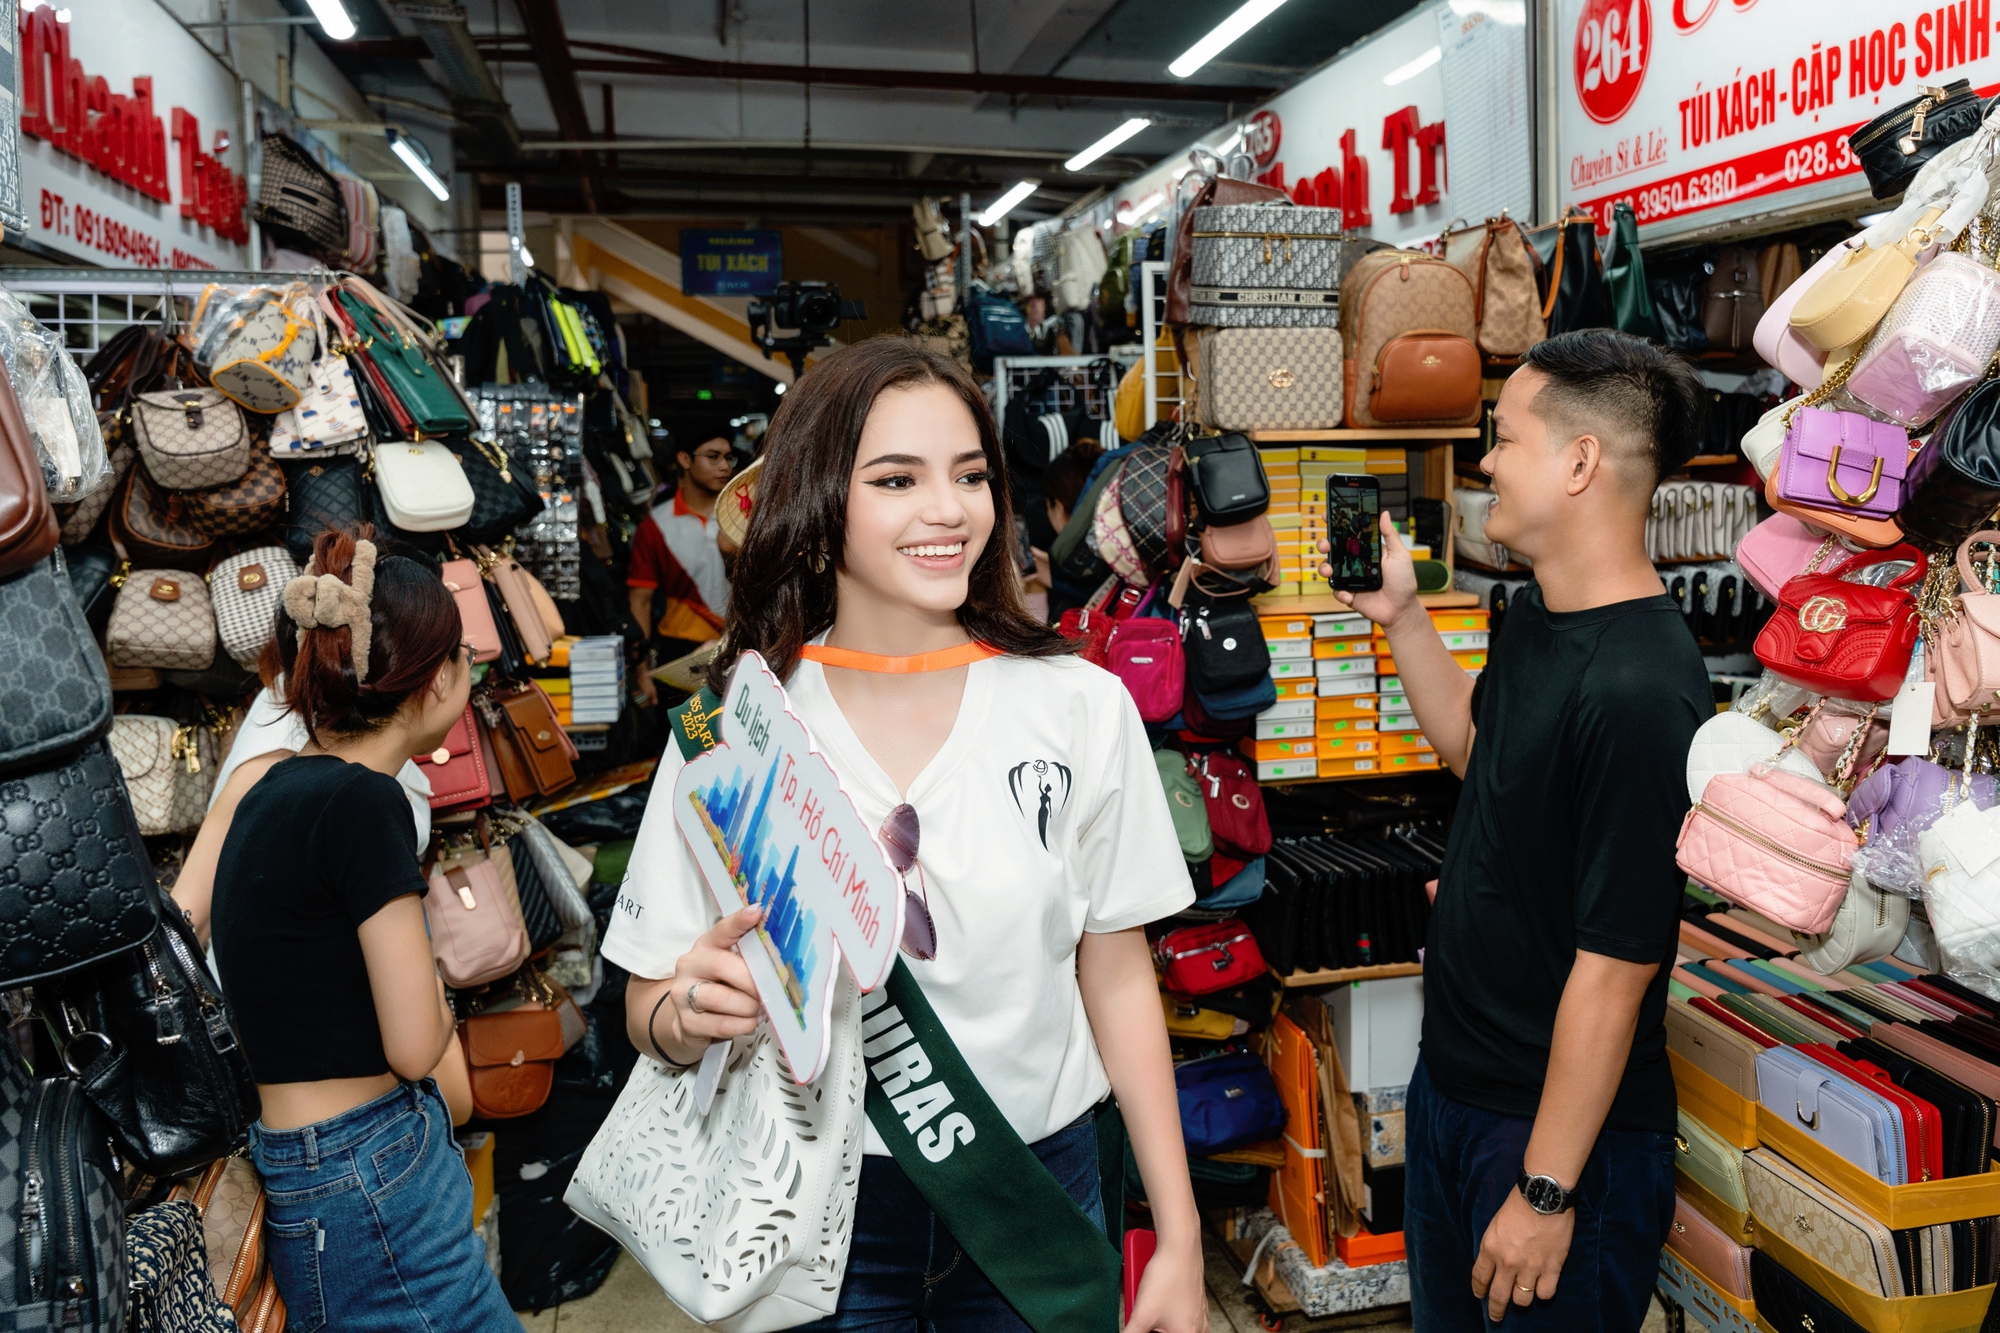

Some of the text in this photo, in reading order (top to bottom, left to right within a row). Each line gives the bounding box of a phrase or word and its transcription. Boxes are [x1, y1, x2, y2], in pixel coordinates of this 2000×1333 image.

[1582, 0, 1644, 94] 264
[1679, 81, 1712, 151] TÚI
[1849, 22, 1906, 105] HỌC
[1915, 0, 1990, 78] SINH
[1571, 150, 1612, 186] Chuyên
[1633, 135, 1642, 167] &
[41, 188, 69, 236] ĐT:
[1237, 292, 1325, 303] CHRISTIAN DIOR
[681, 711, 699, 740] 2023
[734, 683, 770, 757] Du lịch
[780, 752, 880, 948] Tp. Hồ Chí Minh
